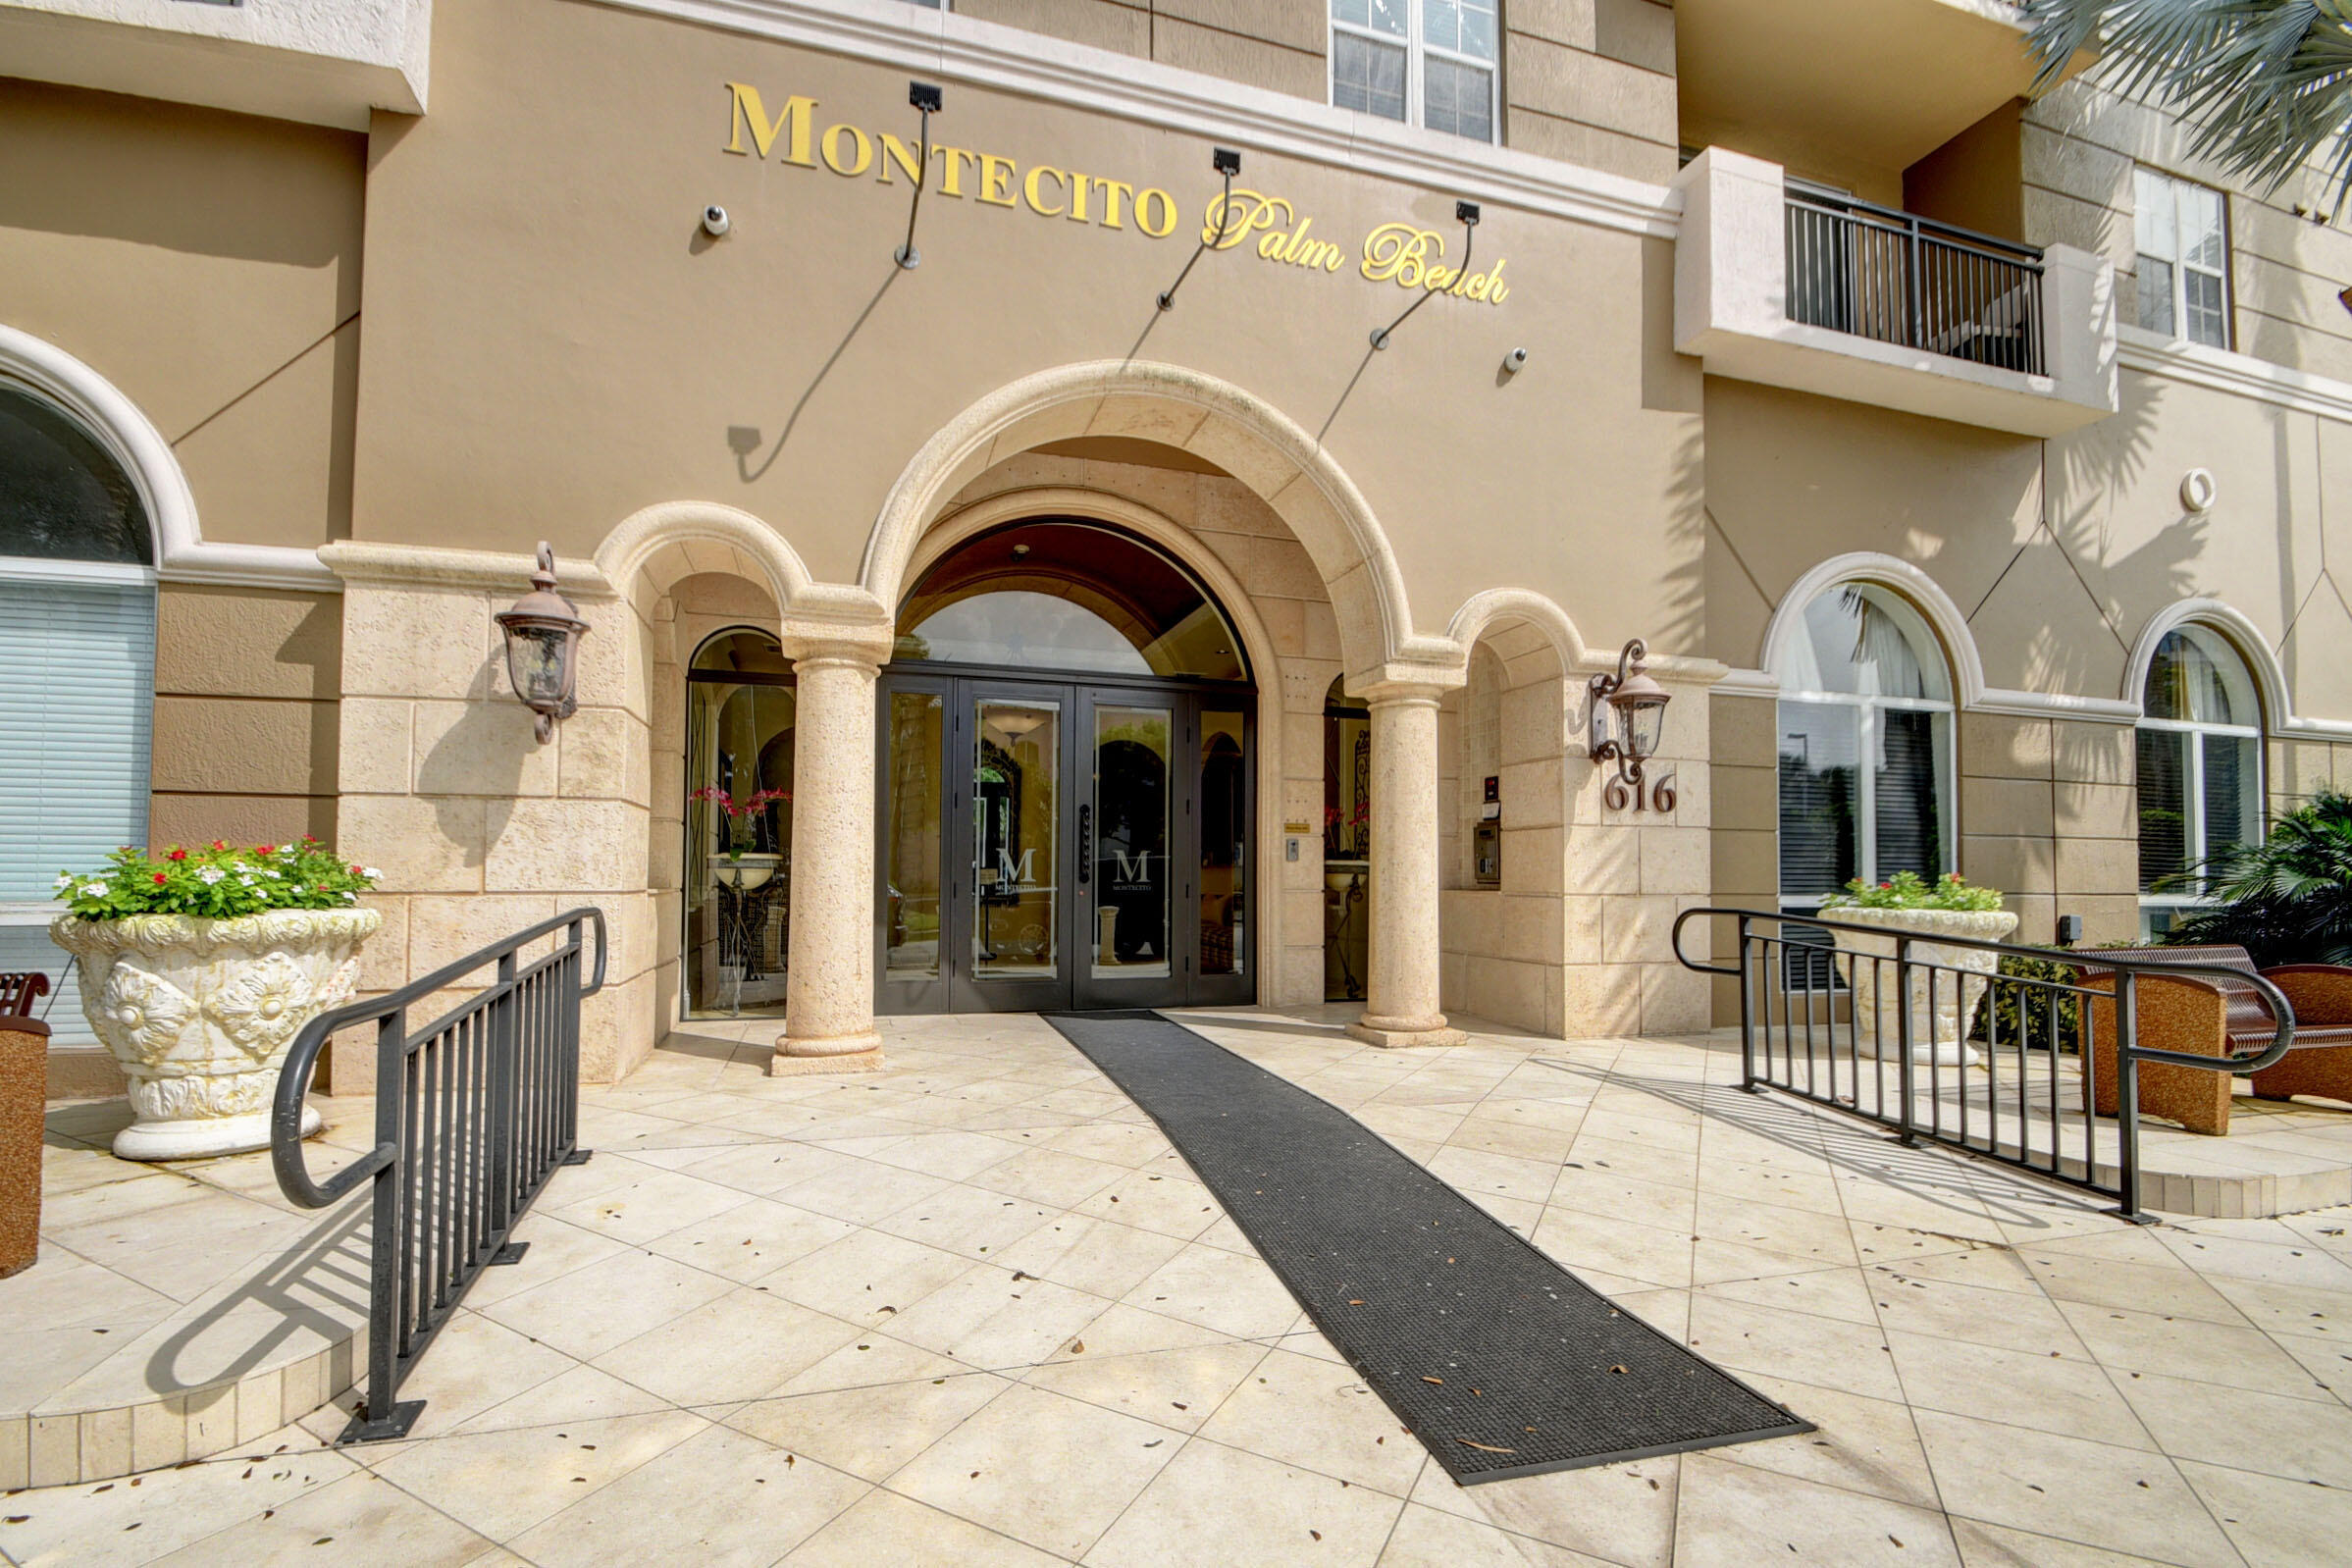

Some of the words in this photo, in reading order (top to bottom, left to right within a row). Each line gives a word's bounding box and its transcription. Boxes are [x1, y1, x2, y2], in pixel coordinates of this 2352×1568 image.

[722, 80, 1178, 239] MONTECITO
[1200, 187, 1346, 273] Palm
[1360, 222, 1511, 305] Beach
[1603, 772, 1677, 813] 616
[995, 848, 1037, 882] M
[1112, 849, 1152, 882] M
